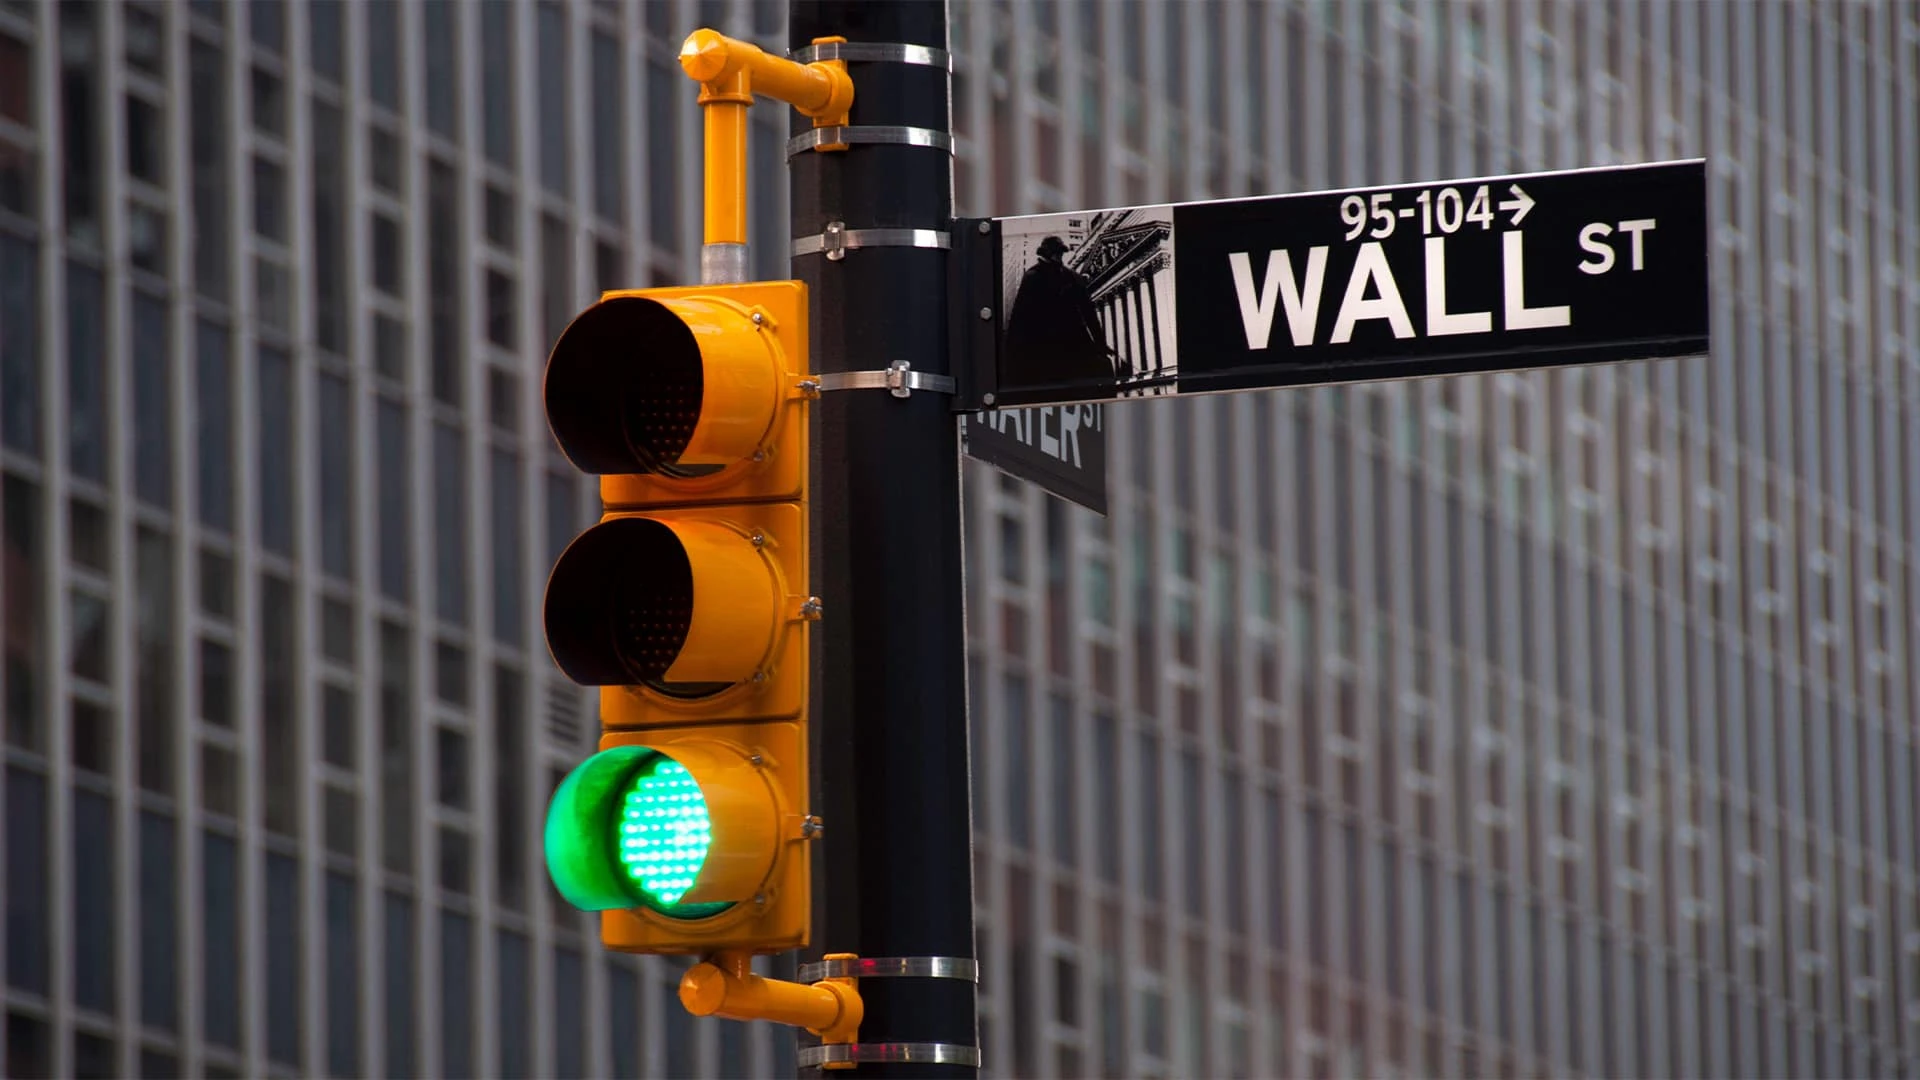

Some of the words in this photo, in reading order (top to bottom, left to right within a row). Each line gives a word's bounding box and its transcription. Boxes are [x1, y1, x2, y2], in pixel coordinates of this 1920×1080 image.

[1340, 185, 1494, 241] 95-104
[1228, 229, 1571, 350] WALL
[1577, 219, 1656, 275] ST
